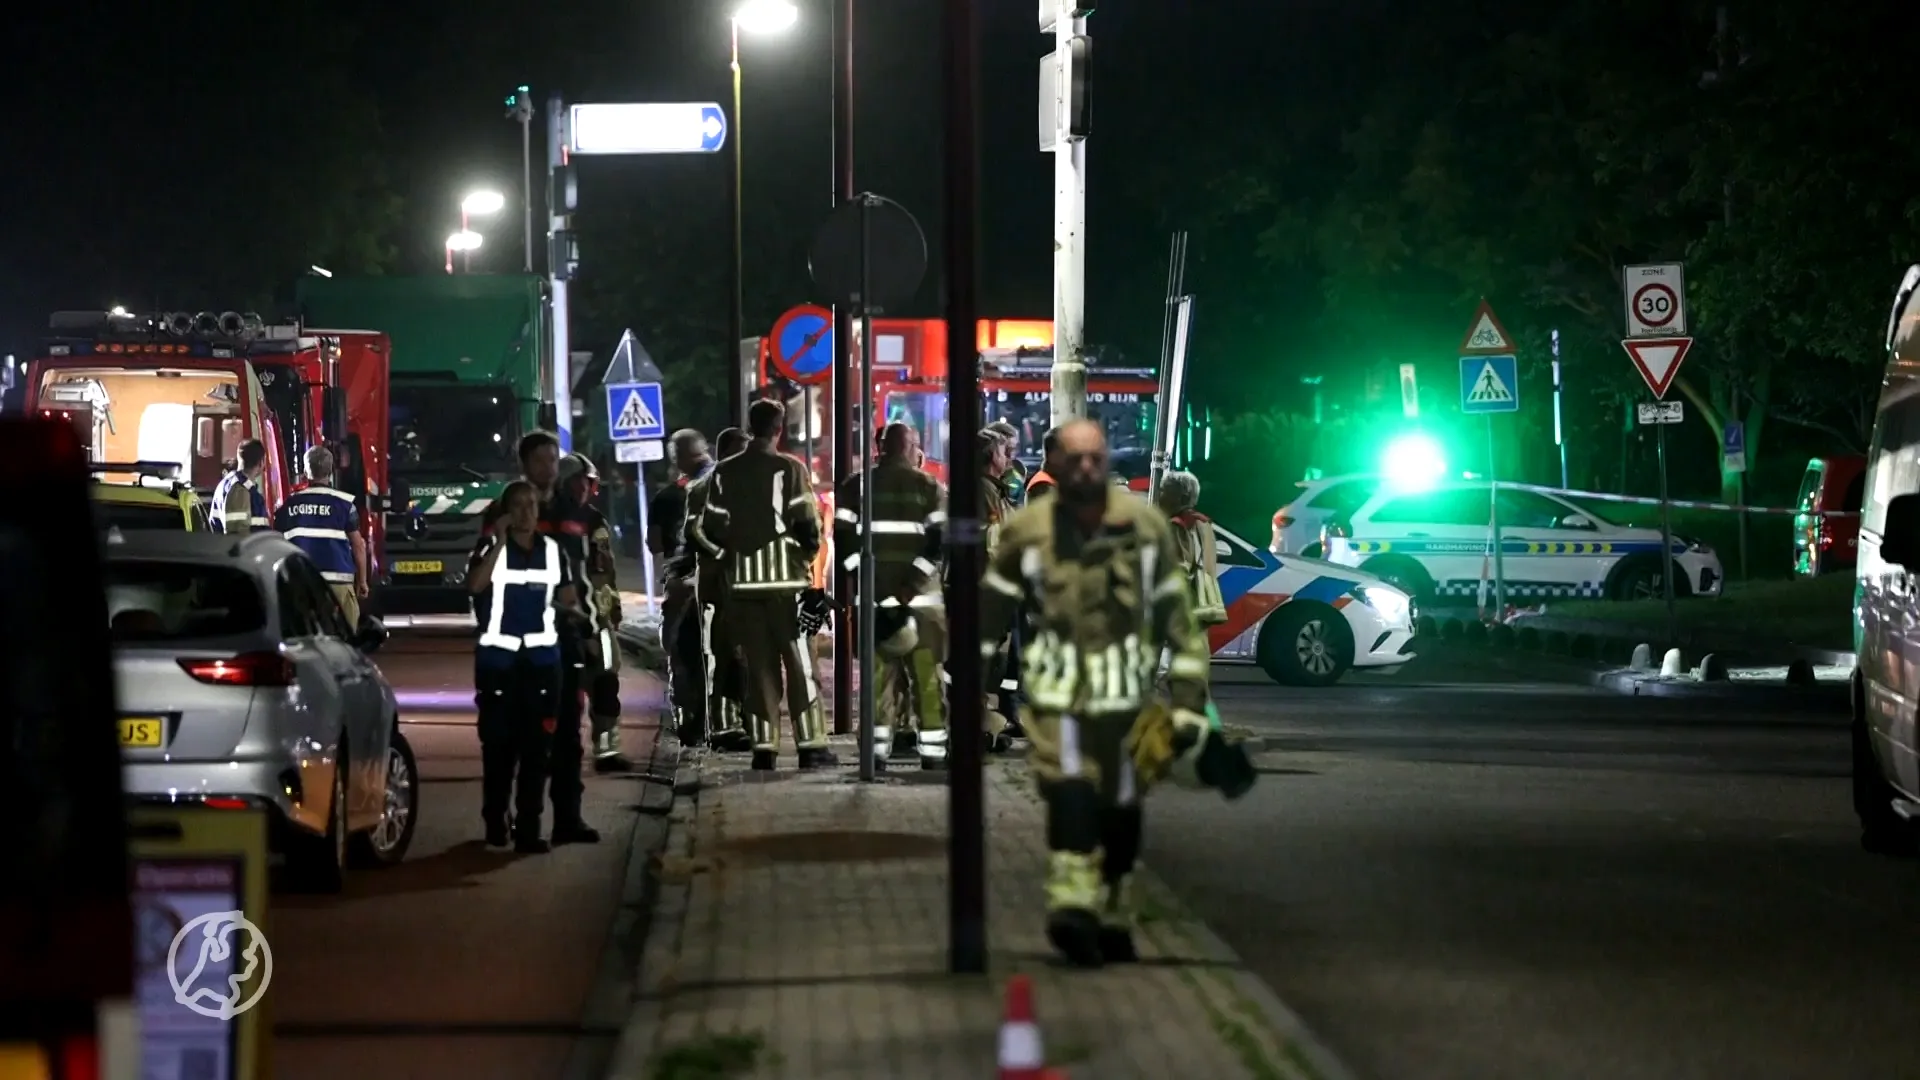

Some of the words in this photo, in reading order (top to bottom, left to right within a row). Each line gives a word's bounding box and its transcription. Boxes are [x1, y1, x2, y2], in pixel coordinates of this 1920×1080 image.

[1642, 268, 1666, 276] ZONE
[1642, 297, 1669, 313] 30
[1024, 391, 1049, 401] ALP
[1109, 392, 1138, 402] RIJN
[288, 503, 331, 517] LOGISTEK
